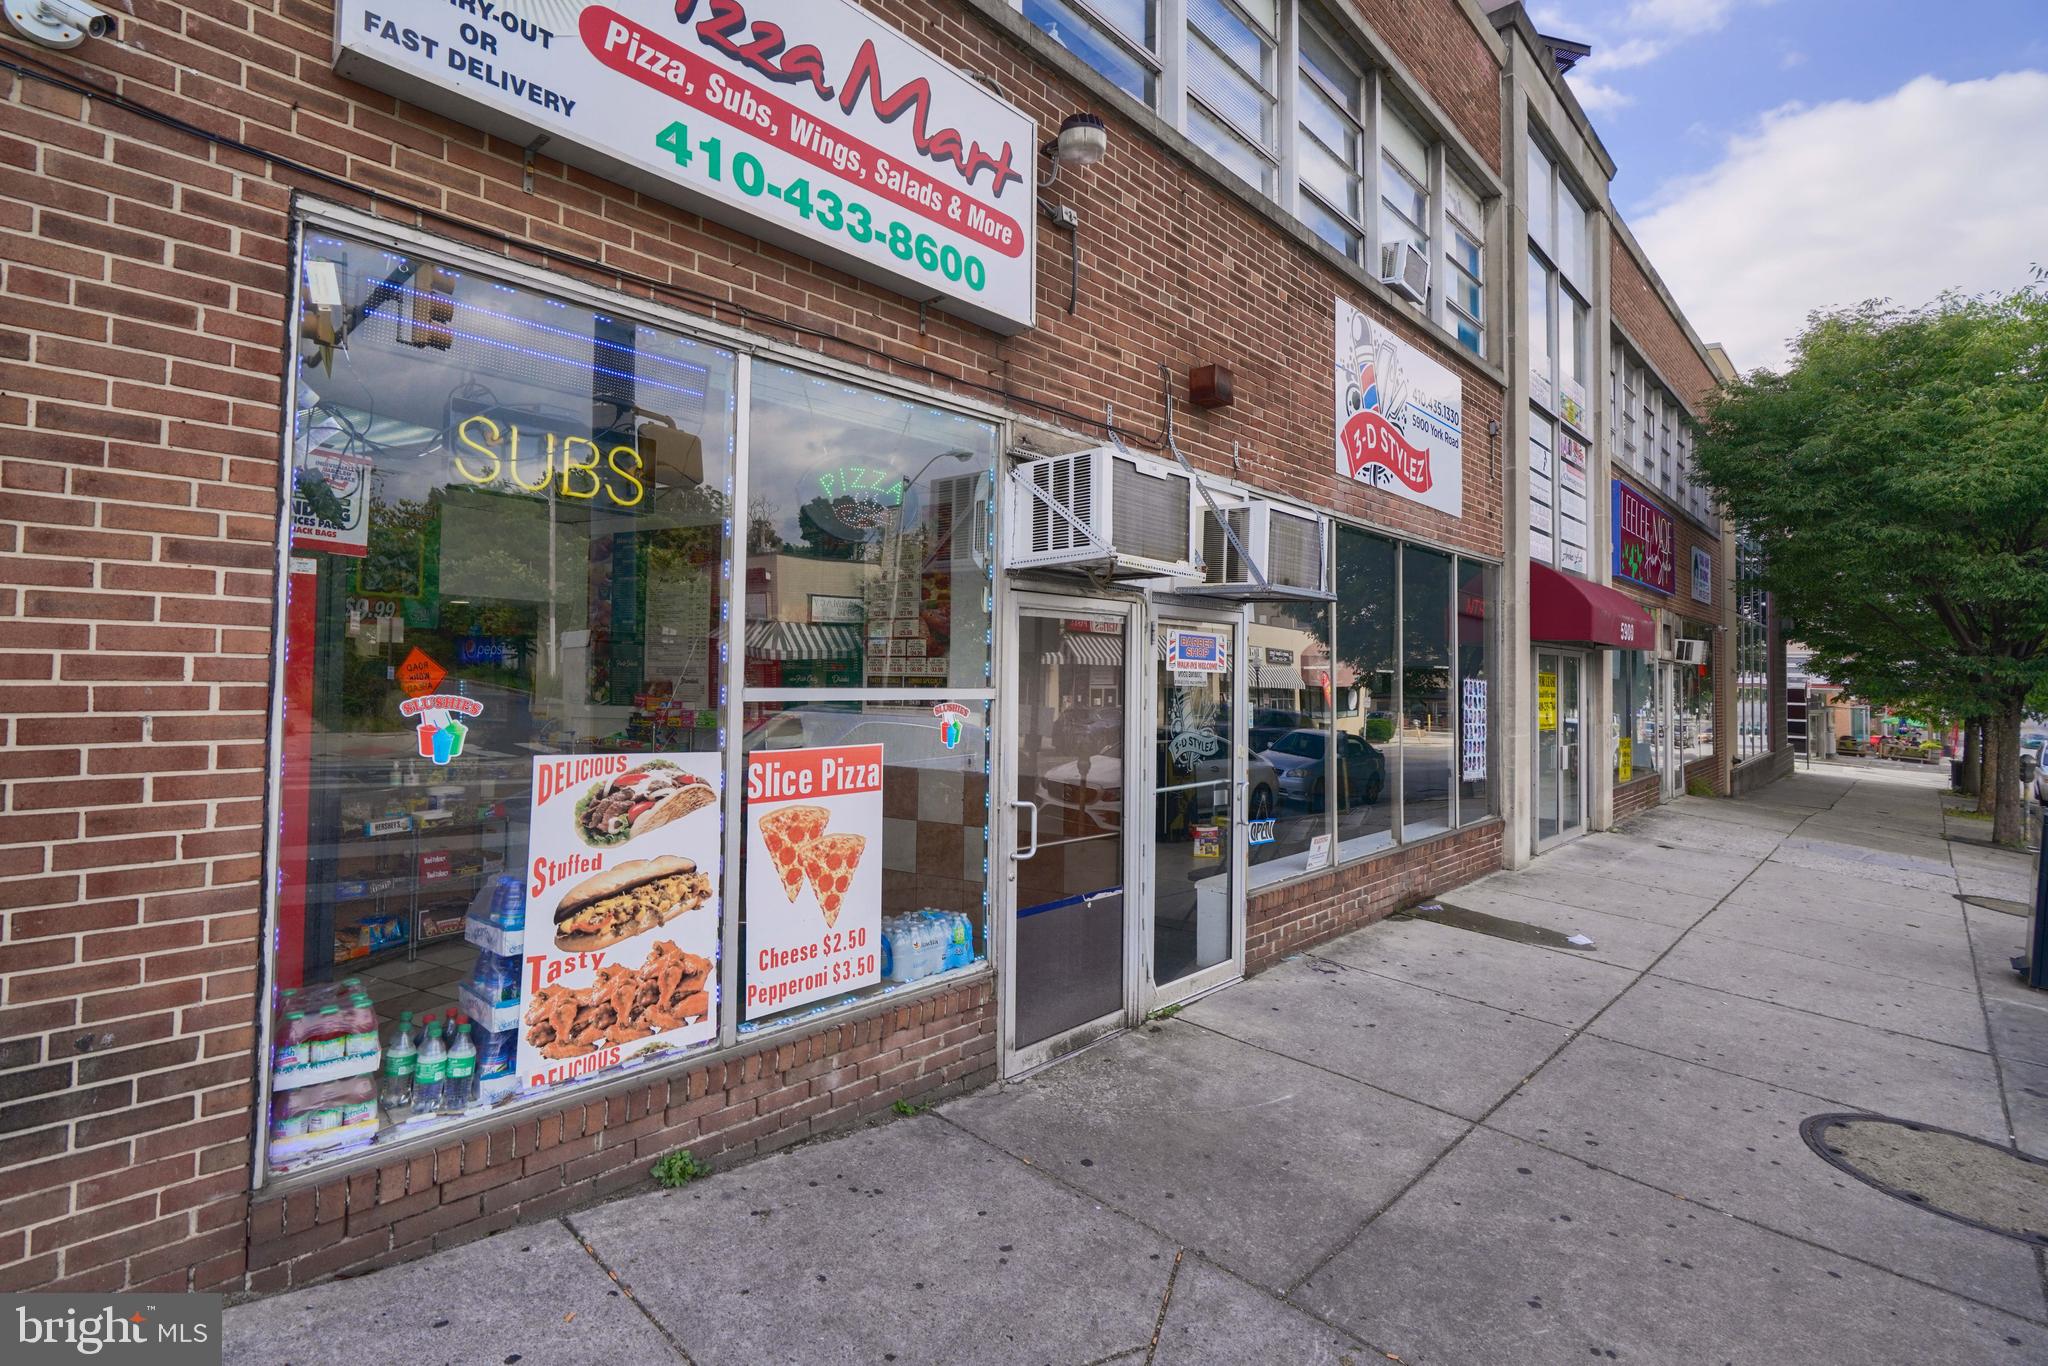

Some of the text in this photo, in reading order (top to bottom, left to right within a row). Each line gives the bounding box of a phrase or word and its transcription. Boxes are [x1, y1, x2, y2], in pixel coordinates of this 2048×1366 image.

[459, 23, 497, 55] OR
[364, 10, 576, 117] FAST DELIVERY
[604, 19, 1013, 246] Pizza, Subs, Wings, Salads & More
[838, 38, 1024, 198] Mart
[655, 120, 986, 292] 410-433-8600
[1412, 388, 1459, 426] 410.435.1330
[1412, 416, 1459, 449] 5900 York Road
[454, 415, 645, 507] SUBS
[1354, 423, 1424, 483] 3-D STYLEZ
[819, 467, 904, 505] PIZZA
[315, 529, 337, 538] BAGS
[1181, 637, 1214, 648] BARBER
[1620, 622, 1634, 641] 5900
[1186, 648, 1209, 657] SHOP
[401, 696, 482, 715] SLUSHIES
[934, 703, 970, 717] SLUSHIES
[1188, 736, 1214, 751] STYLEZ
[538, 755, 628, 806] DELICIOUS
[748, 756, 881, 799] Slice Pizza
[1251, 822, 1273, 841] OPEN
[531, 853, 603, 899] Stuffed
[759, 927, 867, 972] Cheese $2.50
[526, 951, 607, 994] Tasty
[747, 954, 875, 1008] Pepperoni $3.50
